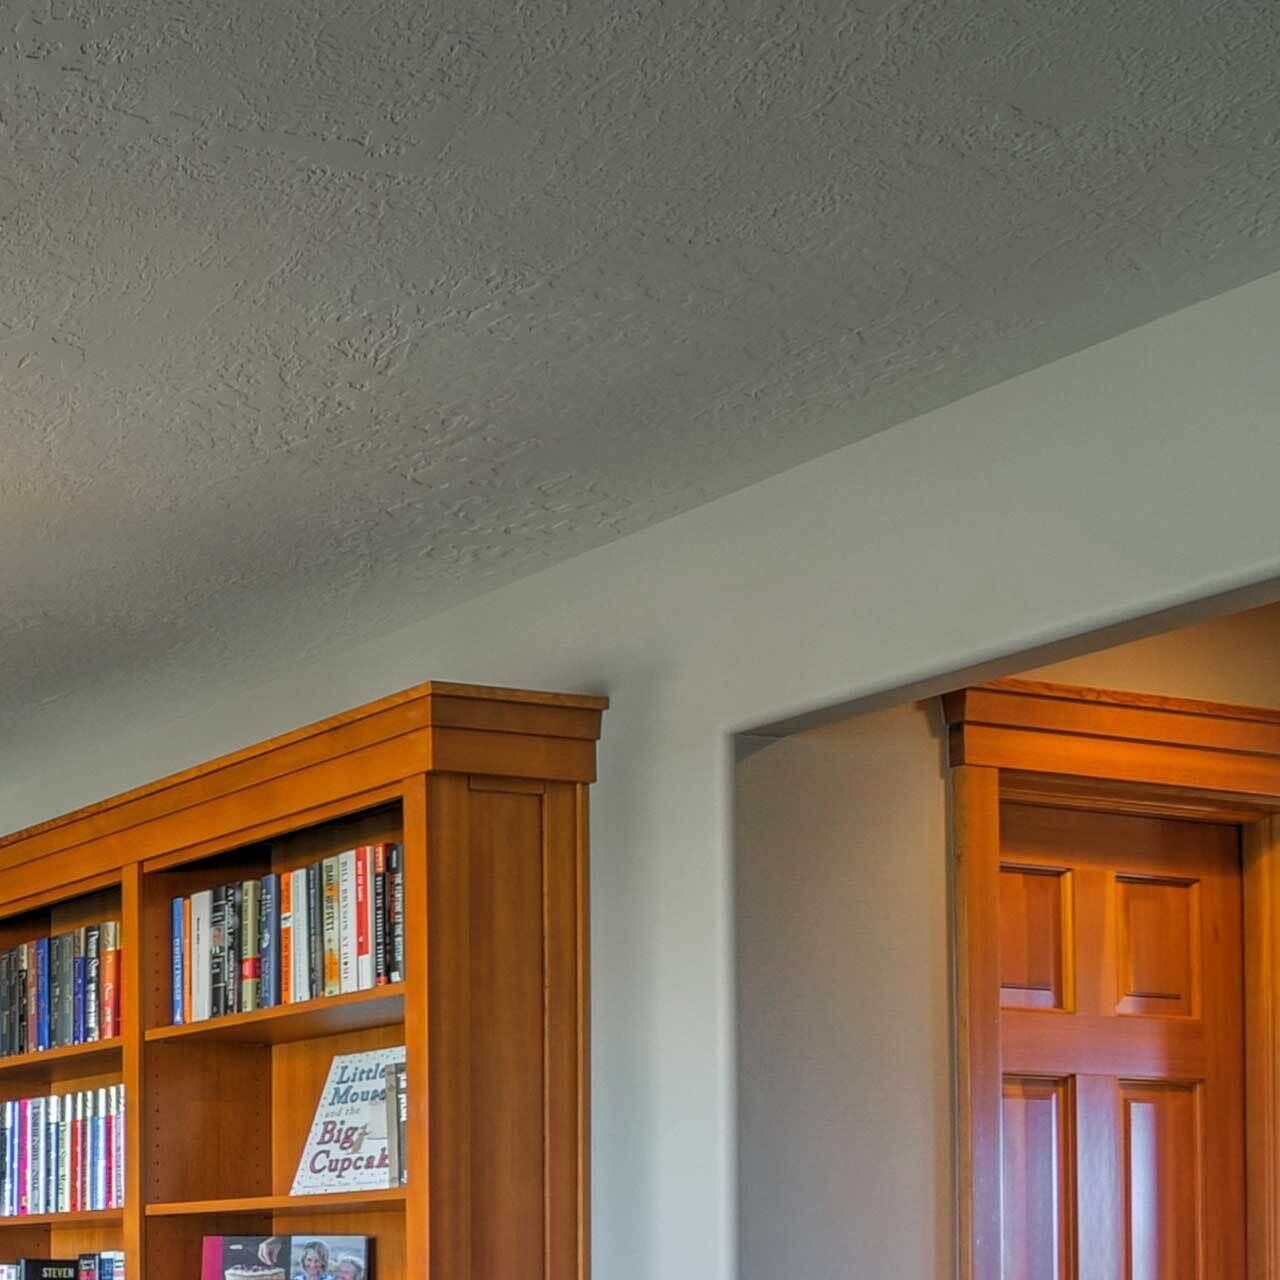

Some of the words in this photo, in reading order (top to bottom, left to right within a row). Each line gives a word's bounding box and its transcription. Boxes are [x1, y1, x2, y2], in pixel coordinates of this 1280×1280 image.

[341, 861, 349, 885] BILL
[341, 888, 349, 931] BRYSON
[341, 936, 349, 949] AT
[341, 953, 349, 980] HOME
[336, 1063, 386, 1085] Little
[328, 1085, 386, 1106] Mouse
[325, 1109, 342, 1118] and
[344, 1106, 361, 1116] the
[316, 1120, 359, 1150] Big
[309, 1148, 389, 1178] Cupcak
[42, 1267, 74, 1278] STEVEN
